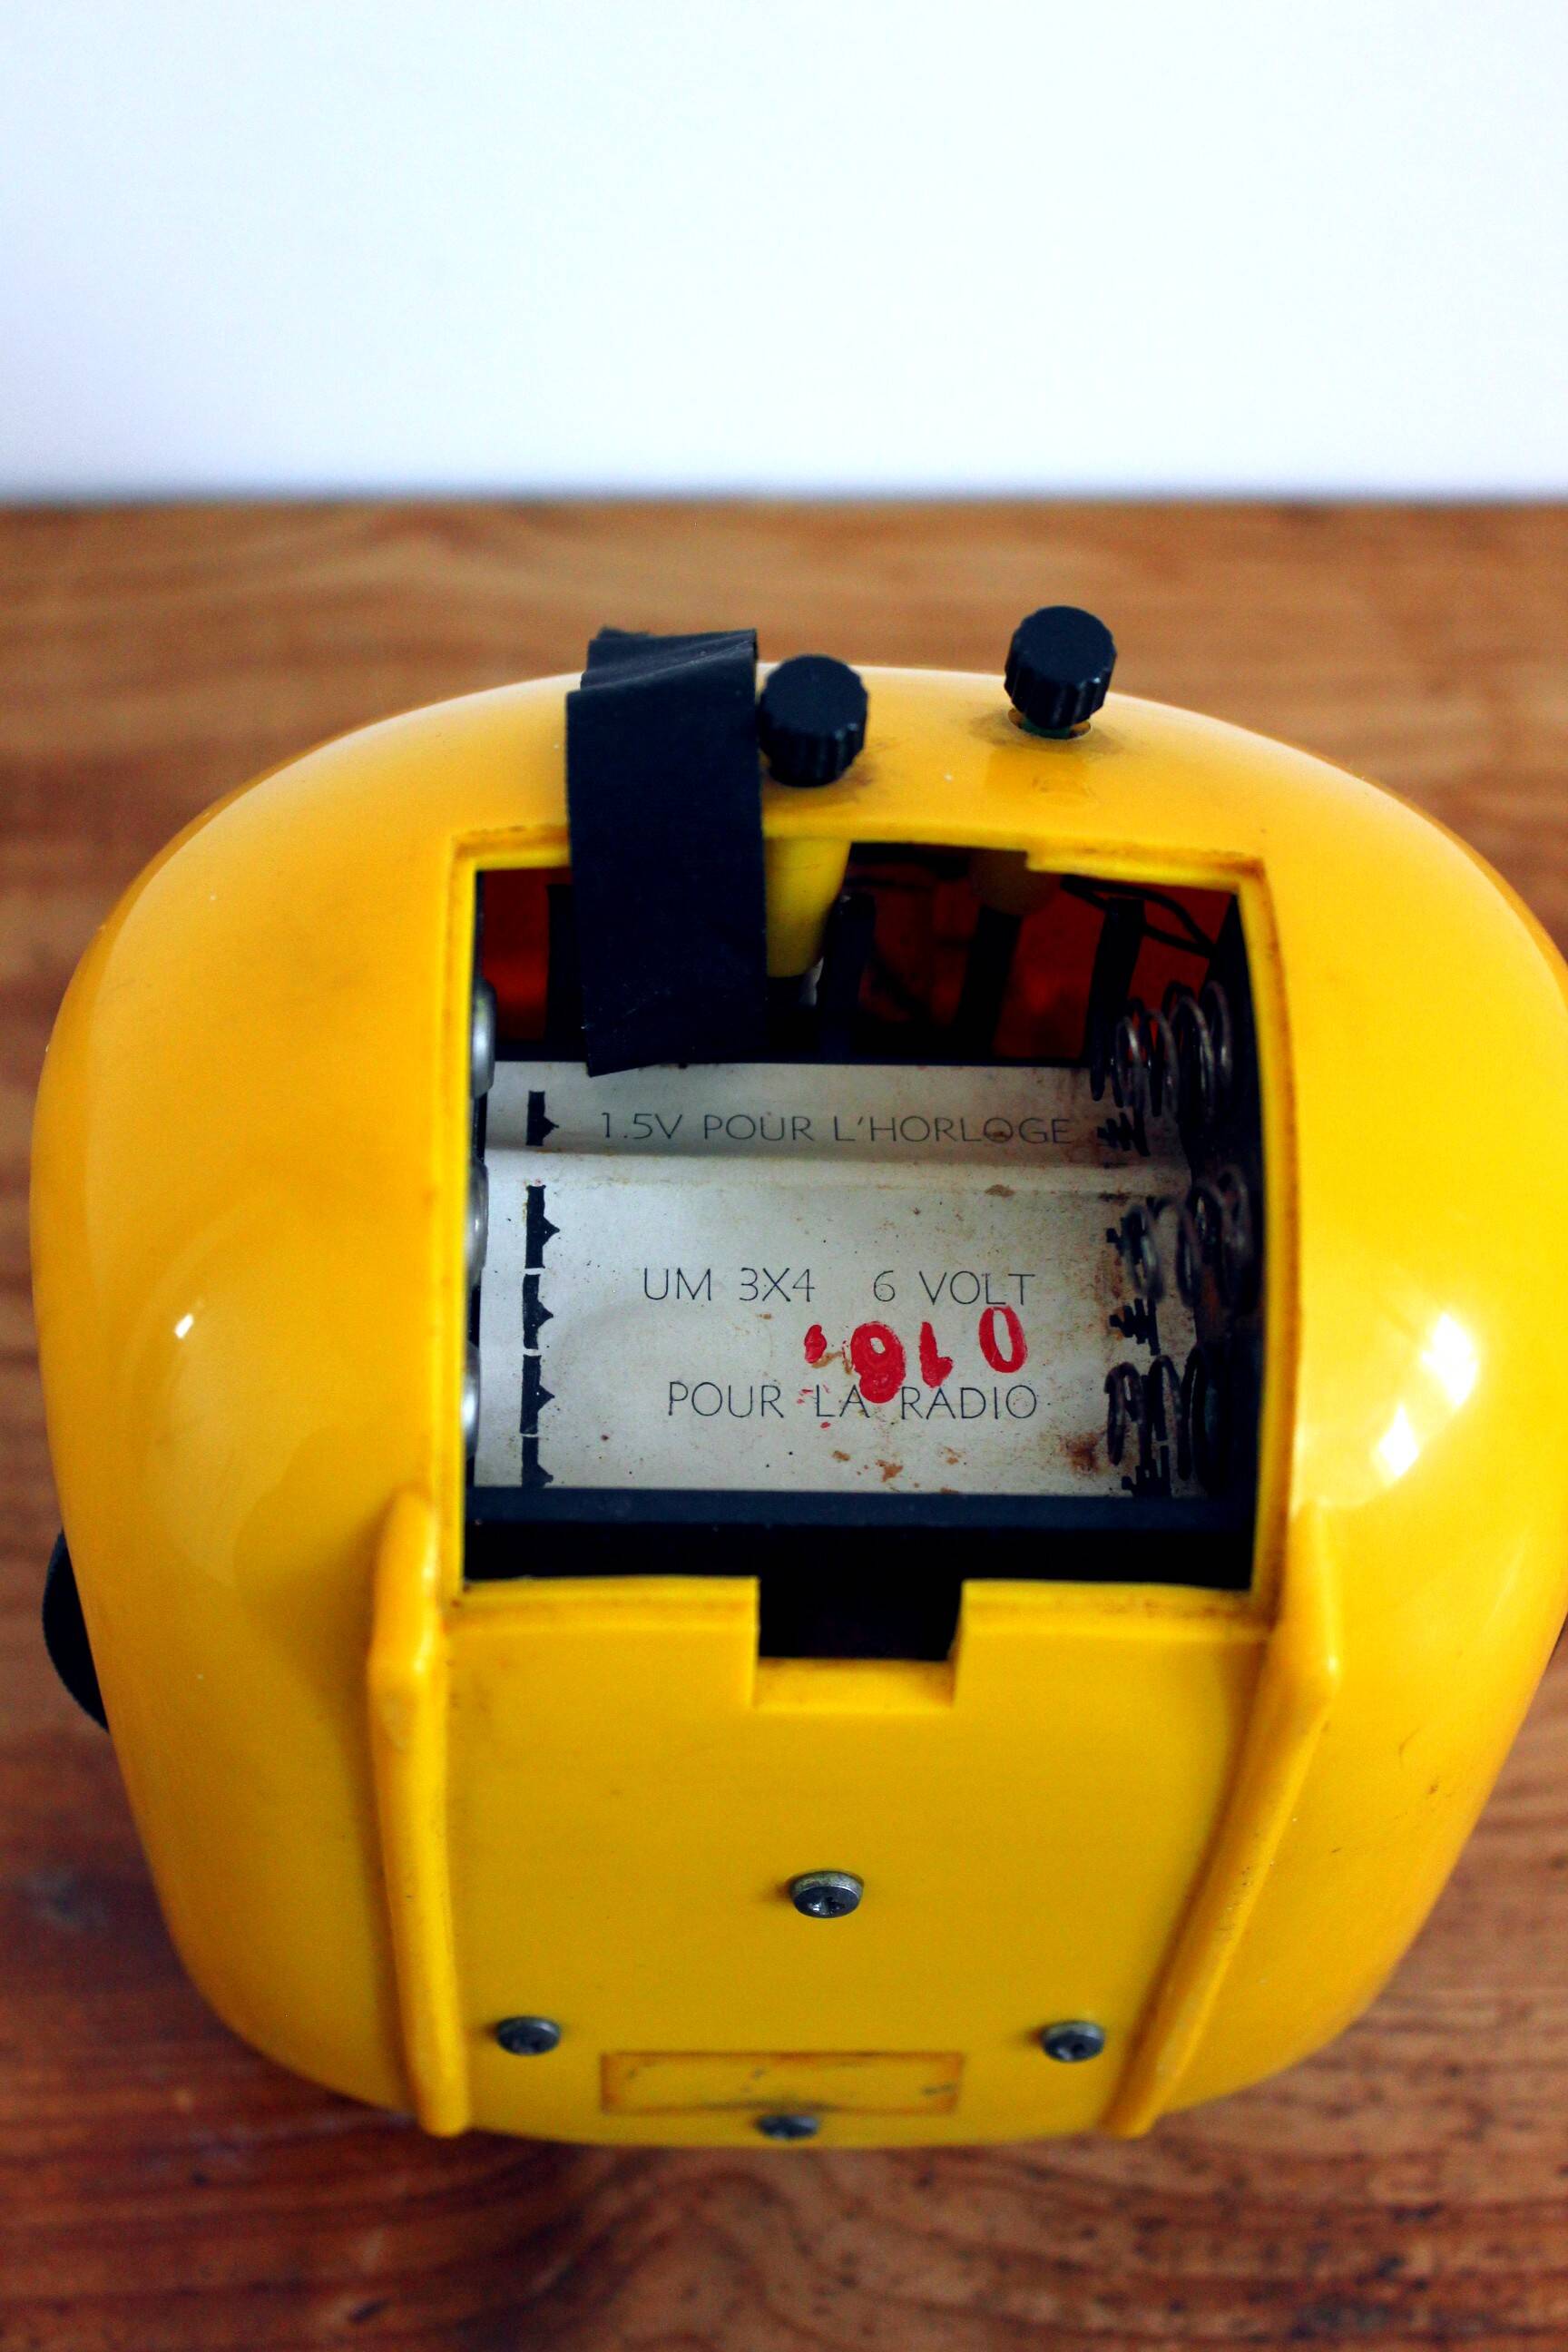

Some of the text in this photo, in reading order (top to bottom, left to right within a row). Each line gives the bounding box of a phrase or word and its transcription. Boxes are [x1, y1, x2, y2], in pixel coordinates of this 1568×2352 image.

[602, 1112, 1073, 1145] 1.5V POUR L'HORLOGE
[643, 1268, 1036, 1306] UM 3X4 6 VOLT
[668, 1381, 1038, 1420] POUR LA RADIO
